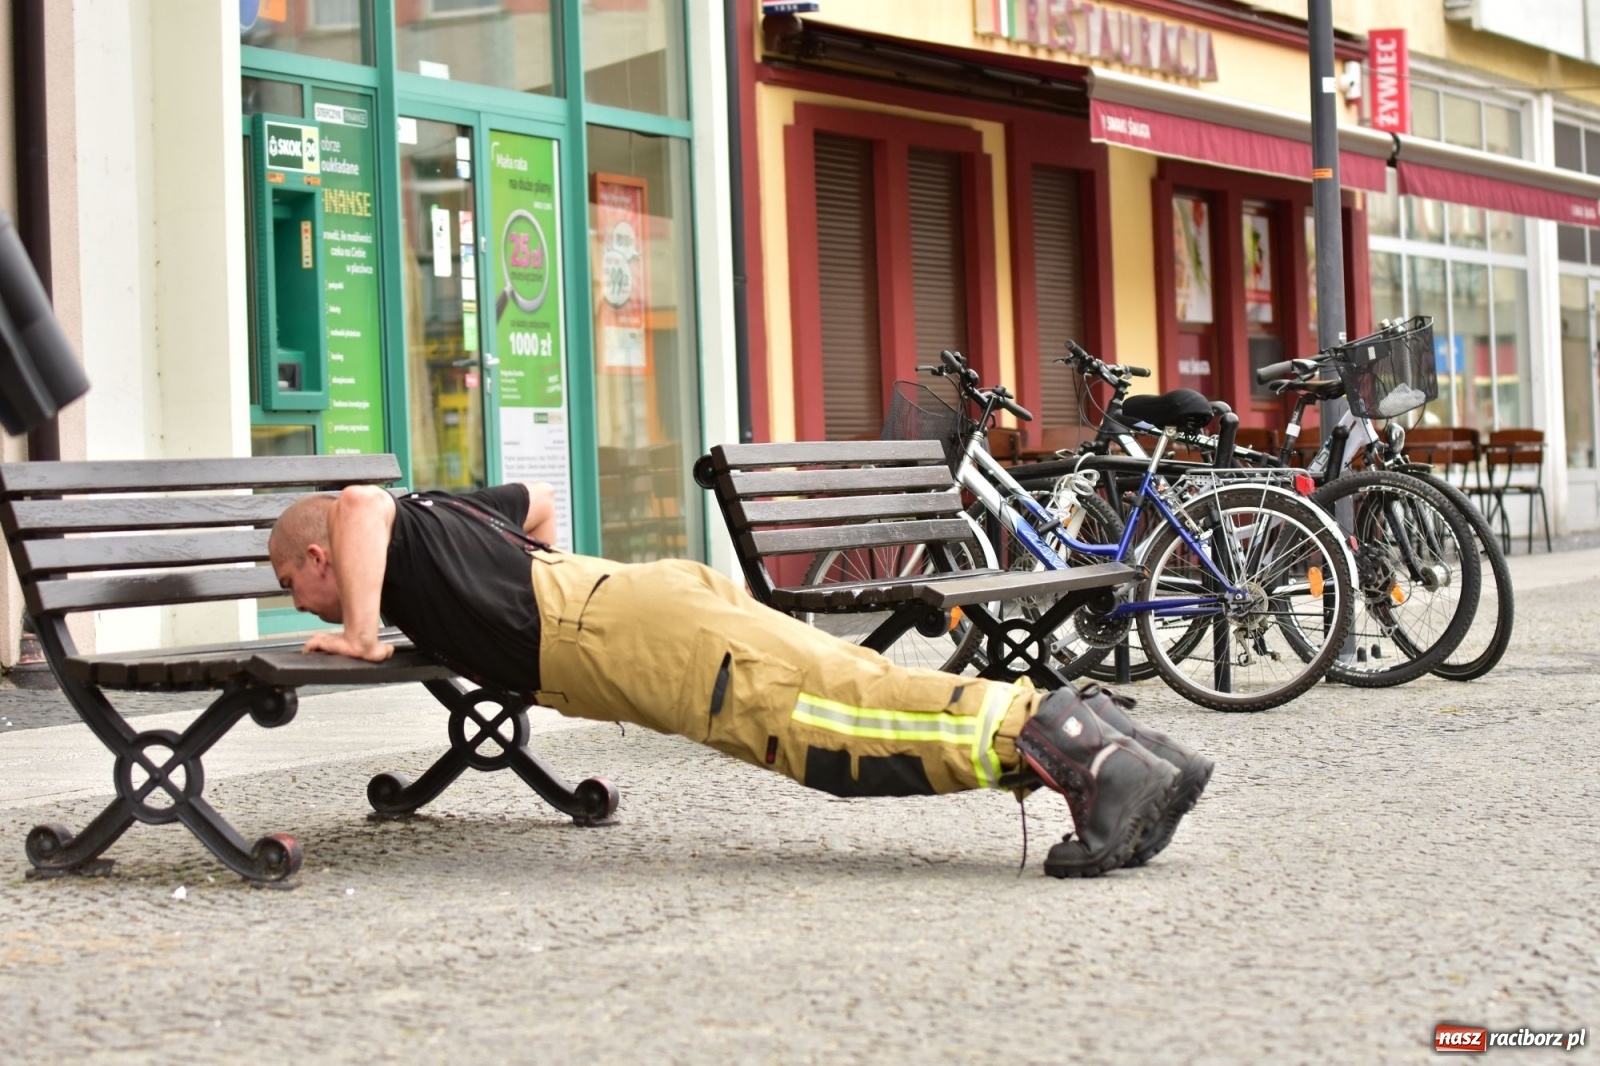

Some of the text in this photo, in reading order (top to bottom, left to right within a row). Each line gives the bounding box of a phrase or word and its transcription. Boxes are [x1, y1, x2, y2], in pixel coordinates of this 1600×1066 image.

[1374, 37, 1400, 128] ŻYWIEC
[278, 138, 302, 157] SKOK
[320, 136, 341, 153] obrze
[322, 187, 372, 217] INANSE
[509, 331, 552, 357] 1000 zł
